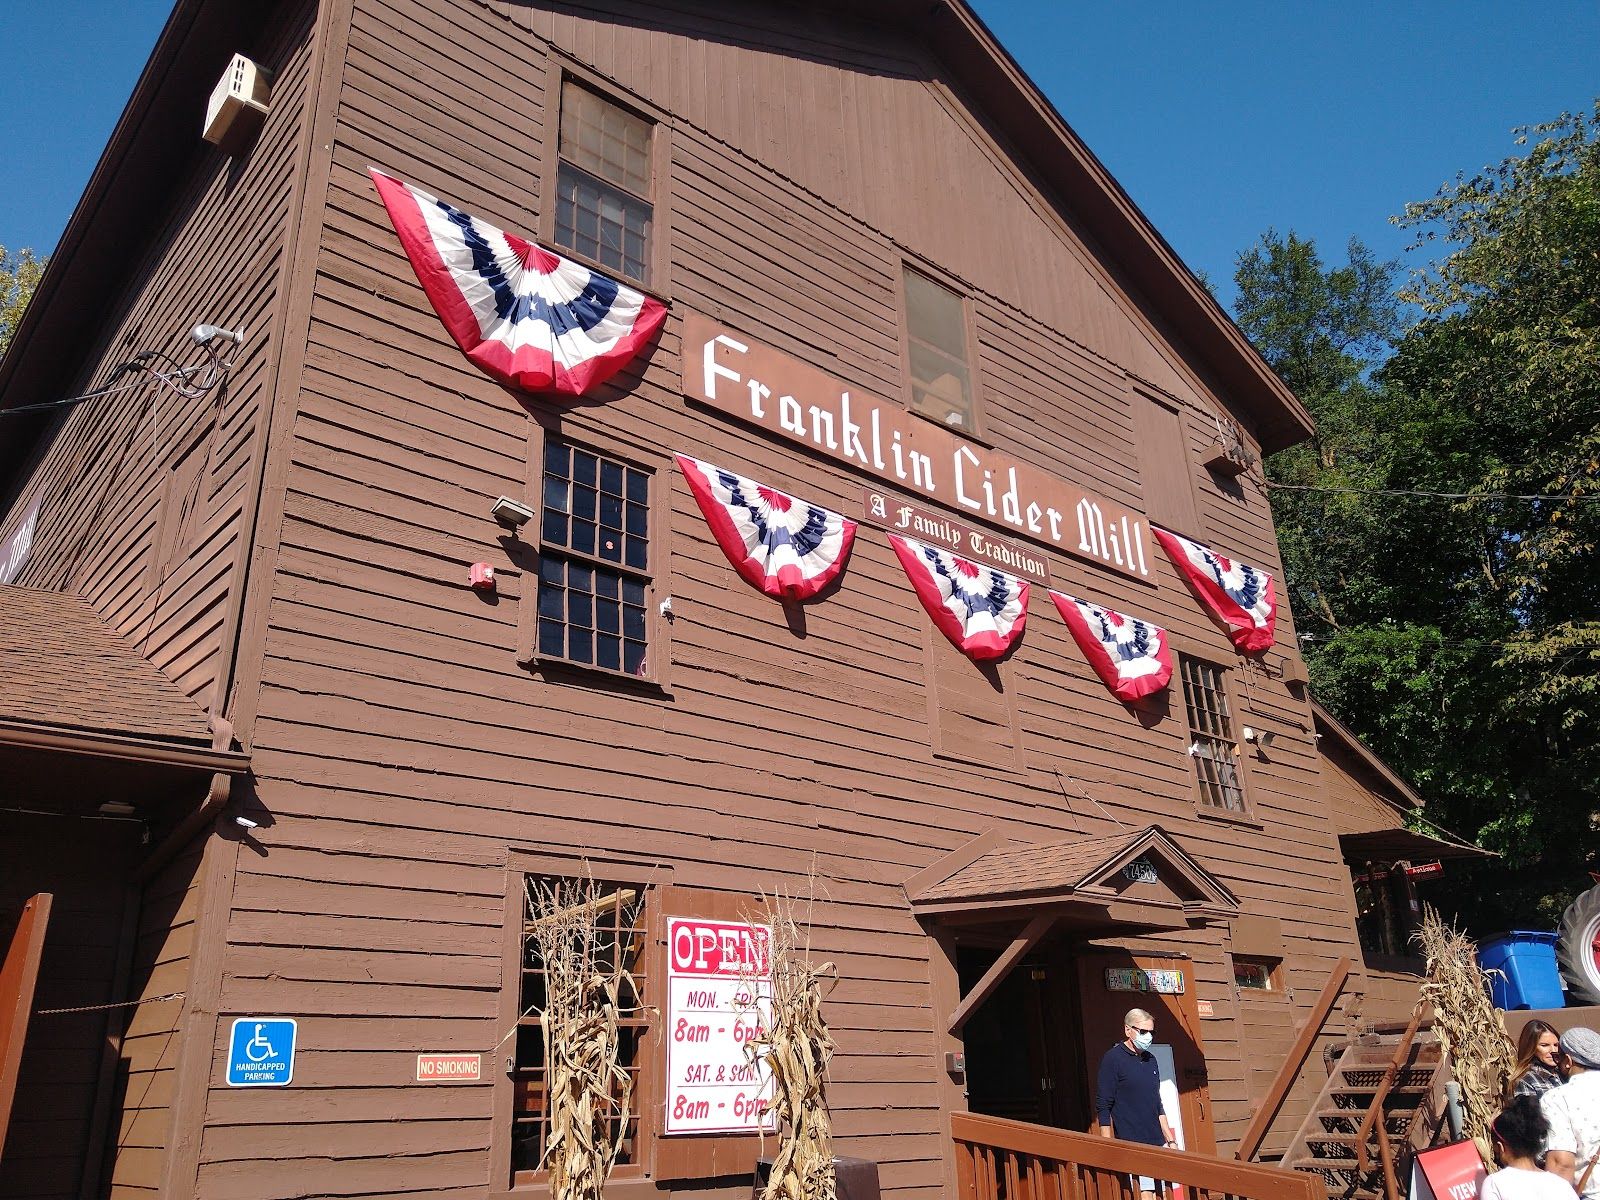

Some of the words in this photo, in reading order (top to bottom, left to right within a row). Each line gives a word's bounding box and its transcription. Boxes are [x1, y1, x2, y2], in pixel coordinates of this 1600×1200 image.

[702, 334, 936, 492] Franklin
[953, 445, 1062, 541] Cider
[1077, 497, 1148, 576] Mill
[869, 493, 888, 518] A
[894, 506, 961, 549] Family
[969, 531, 1046, 577] Tradition
[675, 926, 766, 971] OPEN
[687, 991, 719, 1008] MON.
[674, 1017, 710, 1042] 8am
[235, 1063, 286, 1071] HANDICAPPED
[244, 1072, 275, 1080] PARKING
[420, 1061, 435, 1075] NO
[436, 1060, 478, 1074] SMOKING
[685, 1064, 711, 1083] SAT.
[715, 1064, 726, 1082] &
[729, 1064, 758, 1082] SUN.
[673, 1094, 710, 1120] 8am
